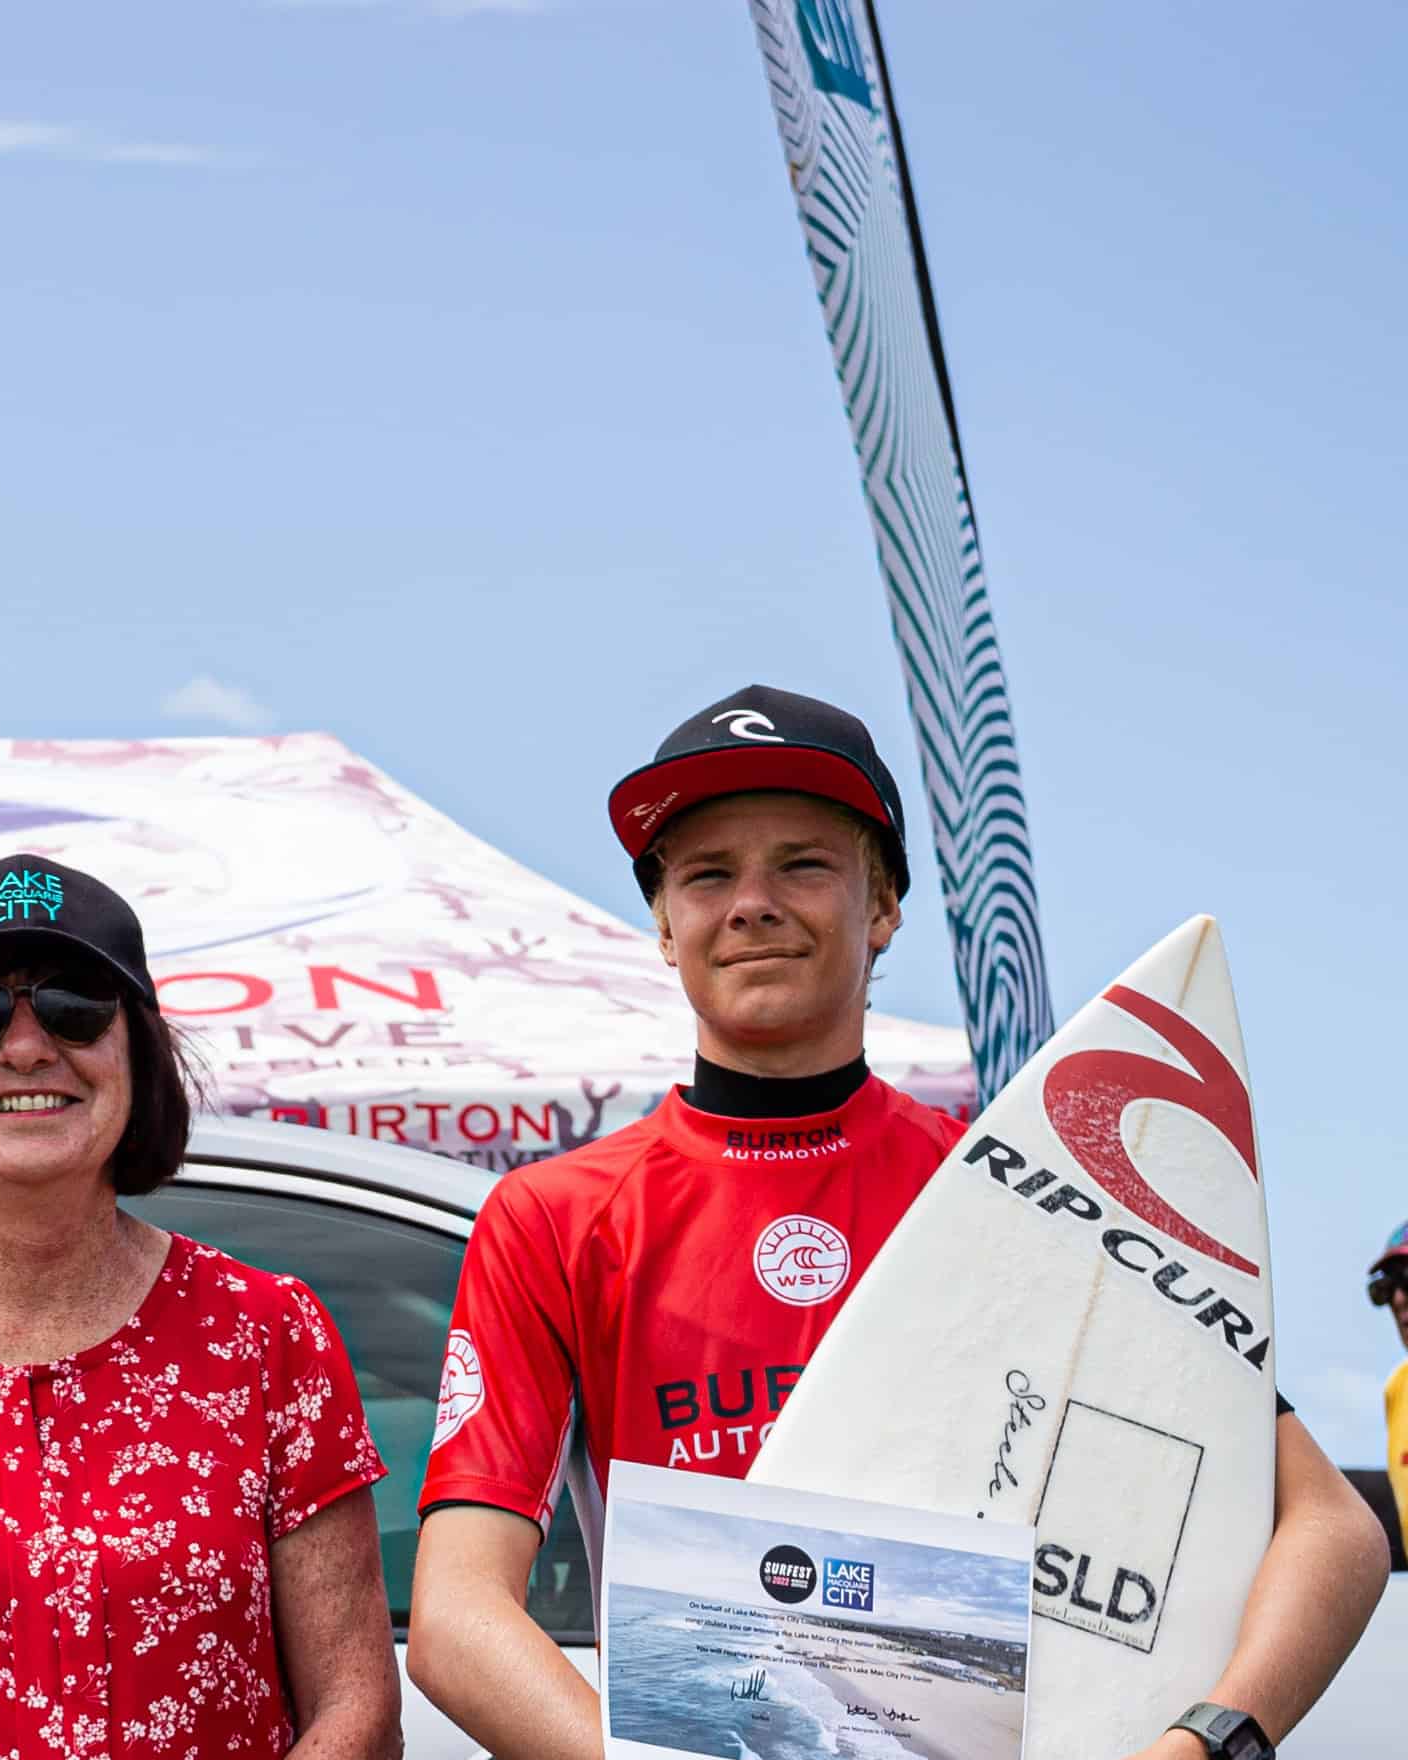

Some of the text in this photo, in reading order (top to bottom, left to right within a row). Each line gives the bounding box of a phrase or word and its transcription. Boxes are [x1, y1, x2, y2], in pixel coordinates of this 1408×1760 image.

[727, 1120, 843, 1148] BURTON
[722, 1138, 851, 1160] AUTOMOTIVE
[962, 1135, 1102, 1221] RIP
[776, 1273, 834, 1287] WSL
[437, 1407, 458, 1425] SL
[764, 1561, 813, 1578] SURFEST
[827, 1562, 870, 1582] LAKE
[1033, 1543, 1157, 1625] SLD
[826, 1587, 869, 1606] CITY
[732, 1608, 748, 1616] Lake
[786, 1615, 800, 1624] City
[794, 1631, 809, 1640] Lake
[811, 1633, 826, 1641] Mac
[853, 1667, 868, 1675] Lake
[870, 1669, 885, 1677] Mac
[886, 1671, 899, 1680] City
